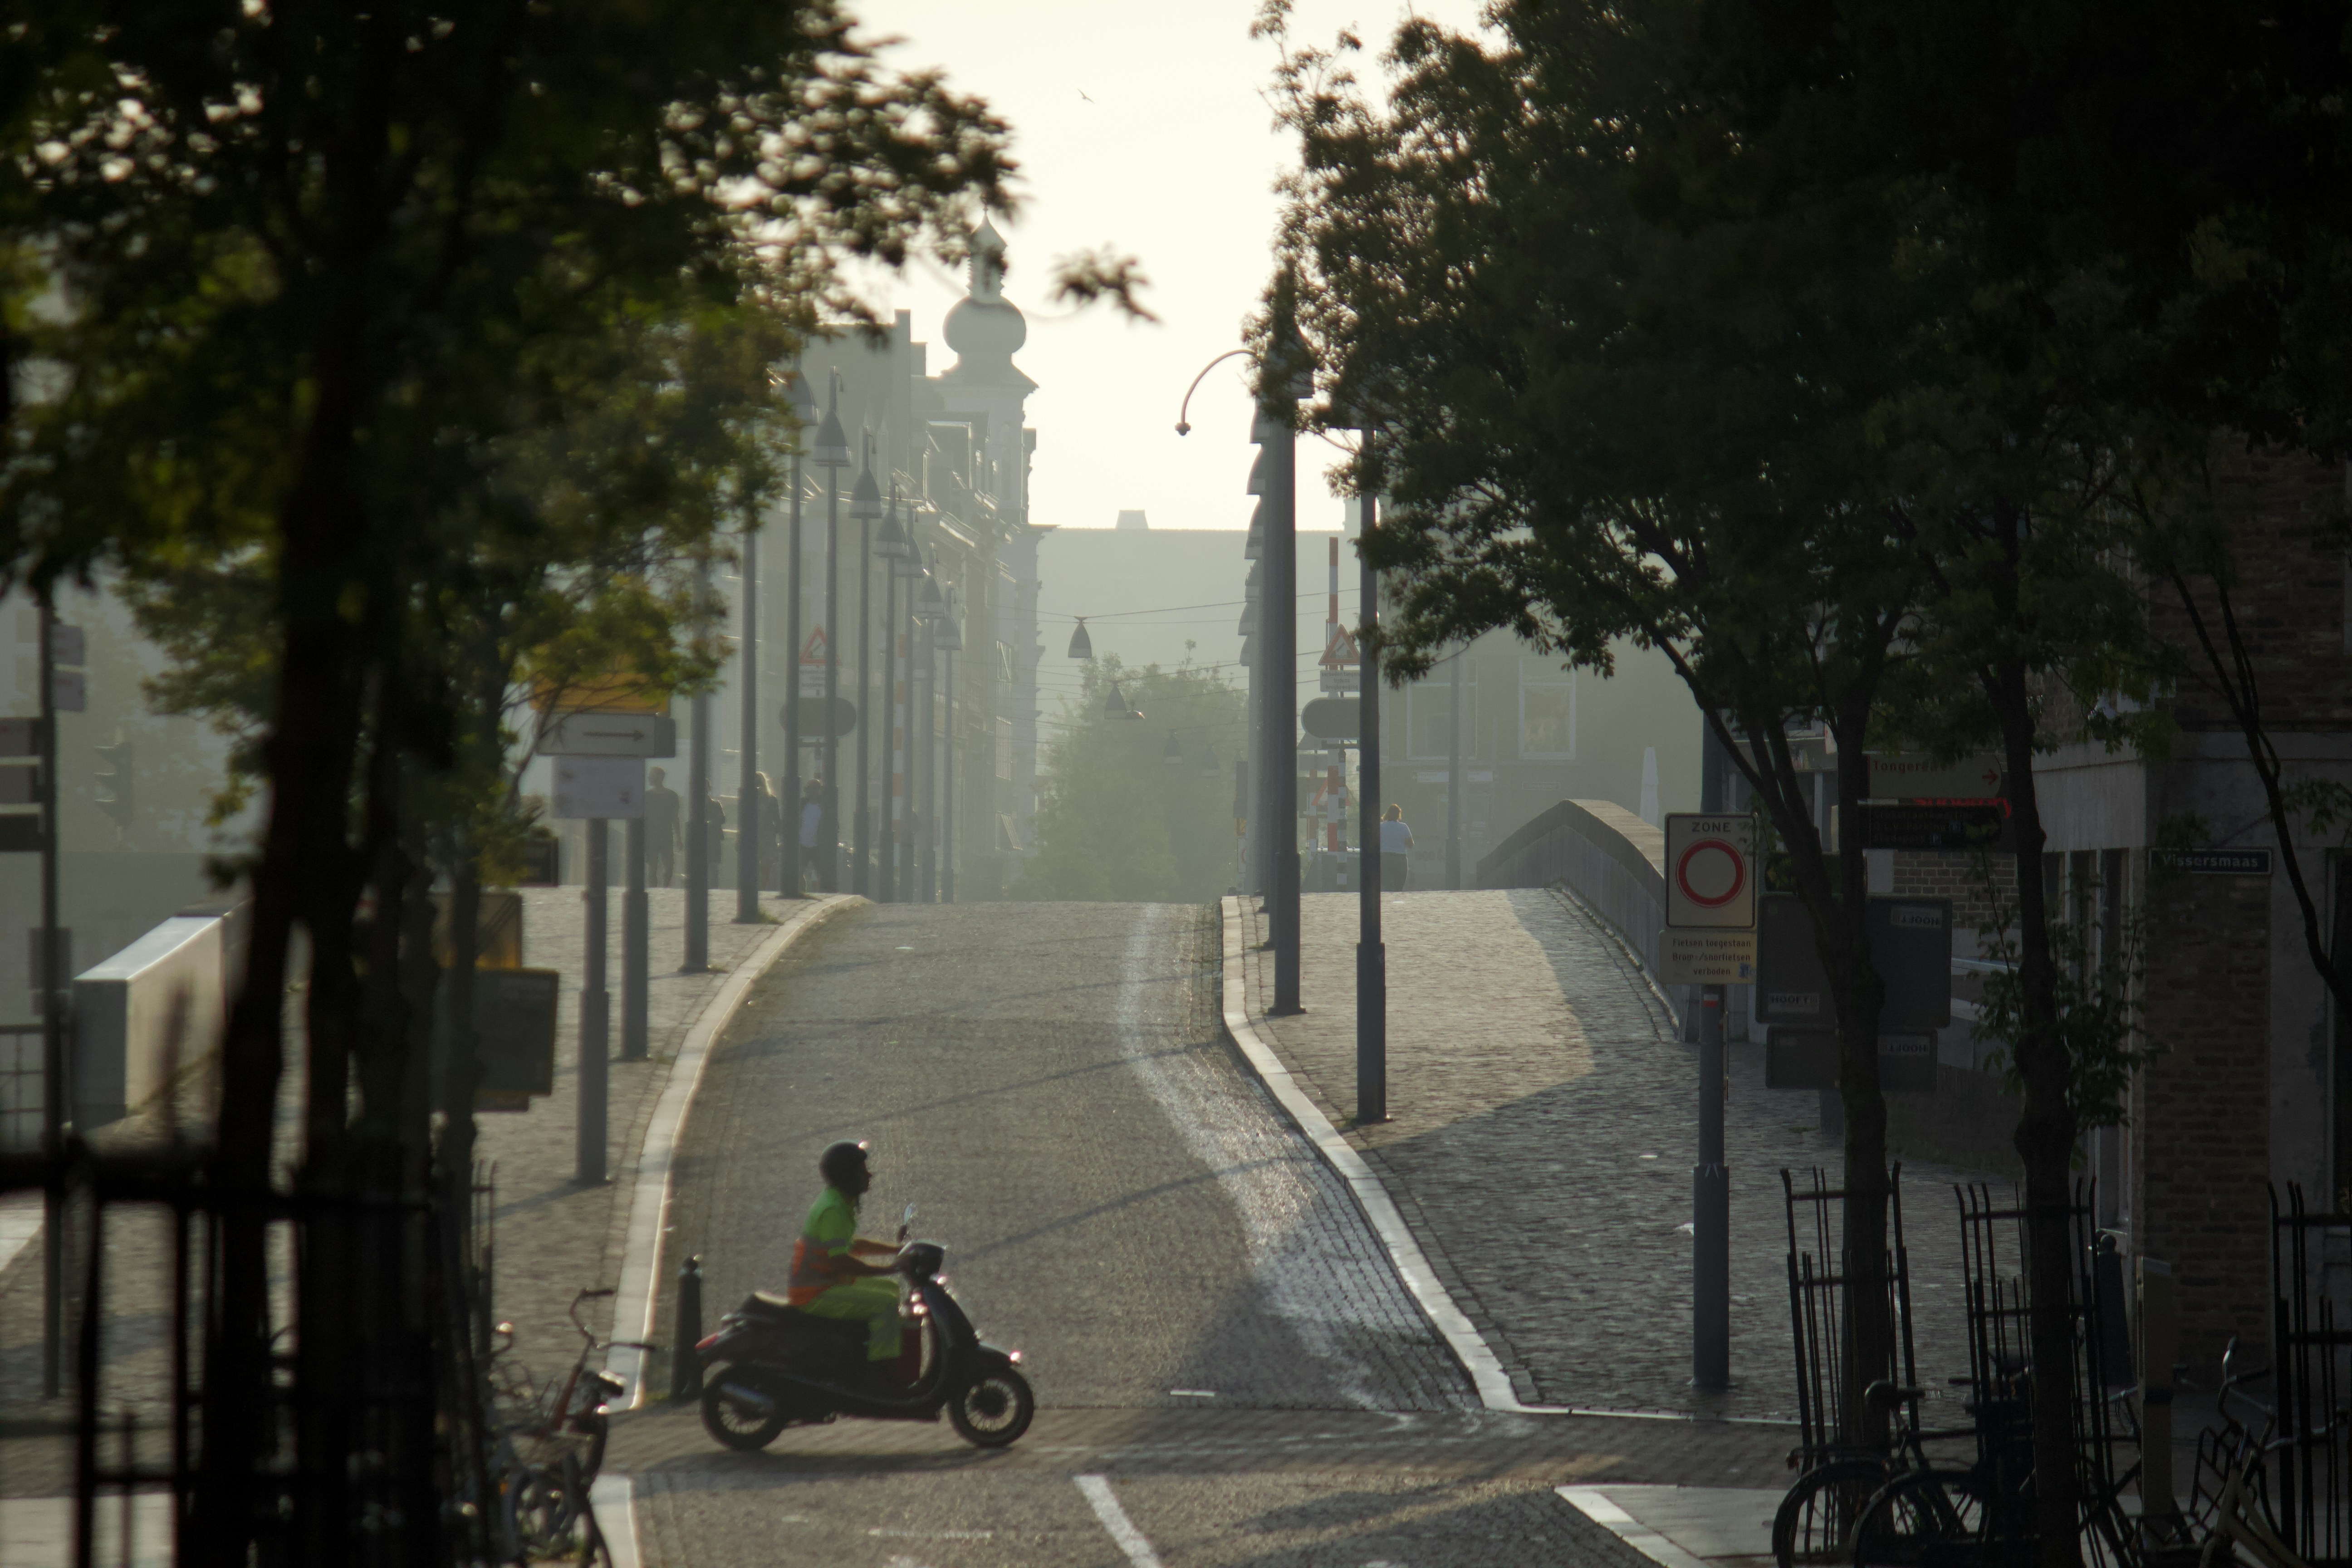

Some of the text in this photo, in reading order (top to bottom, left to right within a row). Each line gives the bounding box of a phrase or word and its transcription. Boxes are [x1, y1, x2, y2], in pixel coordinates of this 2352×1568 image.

[1691, 822, 1731, 832] ZONE
[2163, 854, 2258, 867] Vissersmaas
[1672, 938, 1751, 949] Fietsen toegestaan
[1693, 967, 1730, 975] verboden
